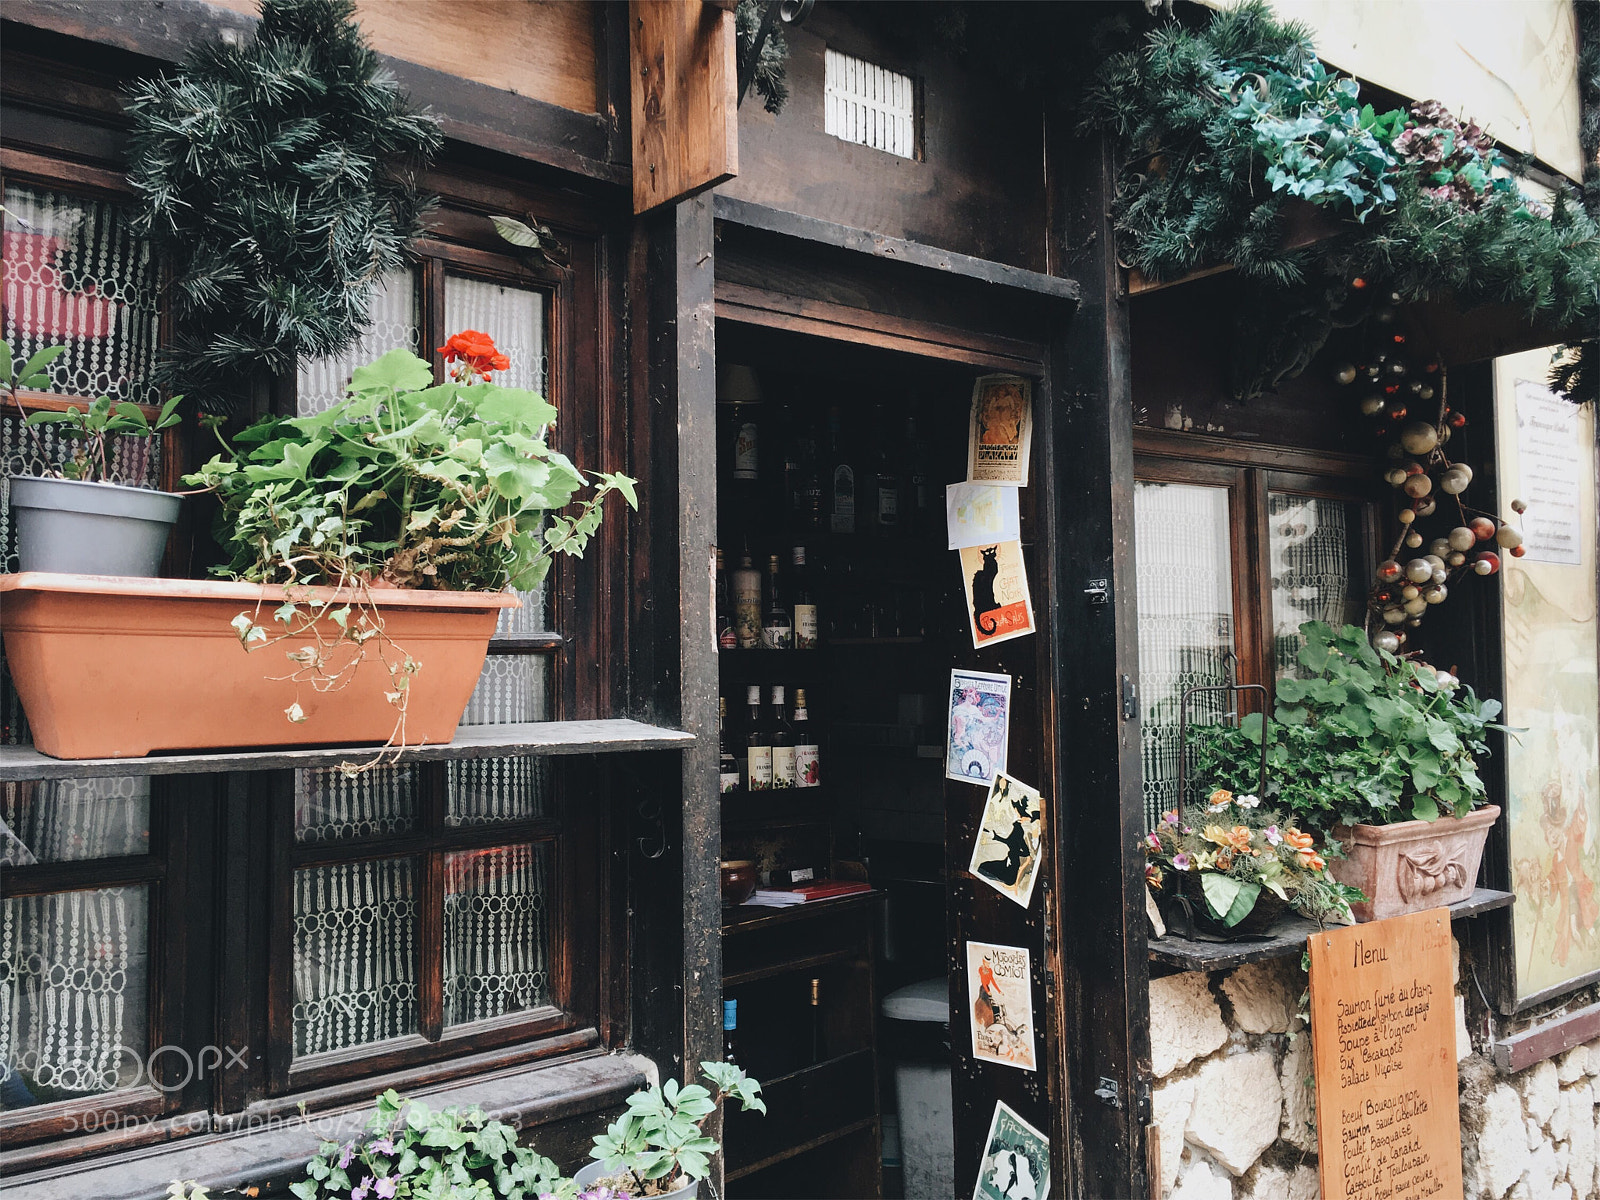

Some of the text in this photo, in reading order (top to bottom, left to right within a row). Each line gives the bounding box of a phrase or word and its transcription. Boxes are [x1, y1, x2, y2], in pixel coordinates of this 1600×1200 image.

[1353, 938, 1388, 968] Menu
[1337, 999, 1371, 1018] Saumon
[1374, 986, 1396, 1019] fumé
[1404, 1003, 1414, 1017] de
[1414, 1002, 1430, 1023] pays
[1338, 1035, 1370, 1055] Soupe
[1339, 1042, 1403, 1071] Six Escargots
[1341, 1067, 1370, 1089] Salade
[1366, 1089, 1420, 1117] Bourguignon
[1342, 1123, 1371, 1143] Saumon
[1343, 1123, 1413, 1161] Poulet Basquaise
[1344, 1155, 1371, 1178] Confit
[1376, 1151, 1388, 1168] de
[1345, 1153, 1430, 1196] Cassoulet Toulousain
